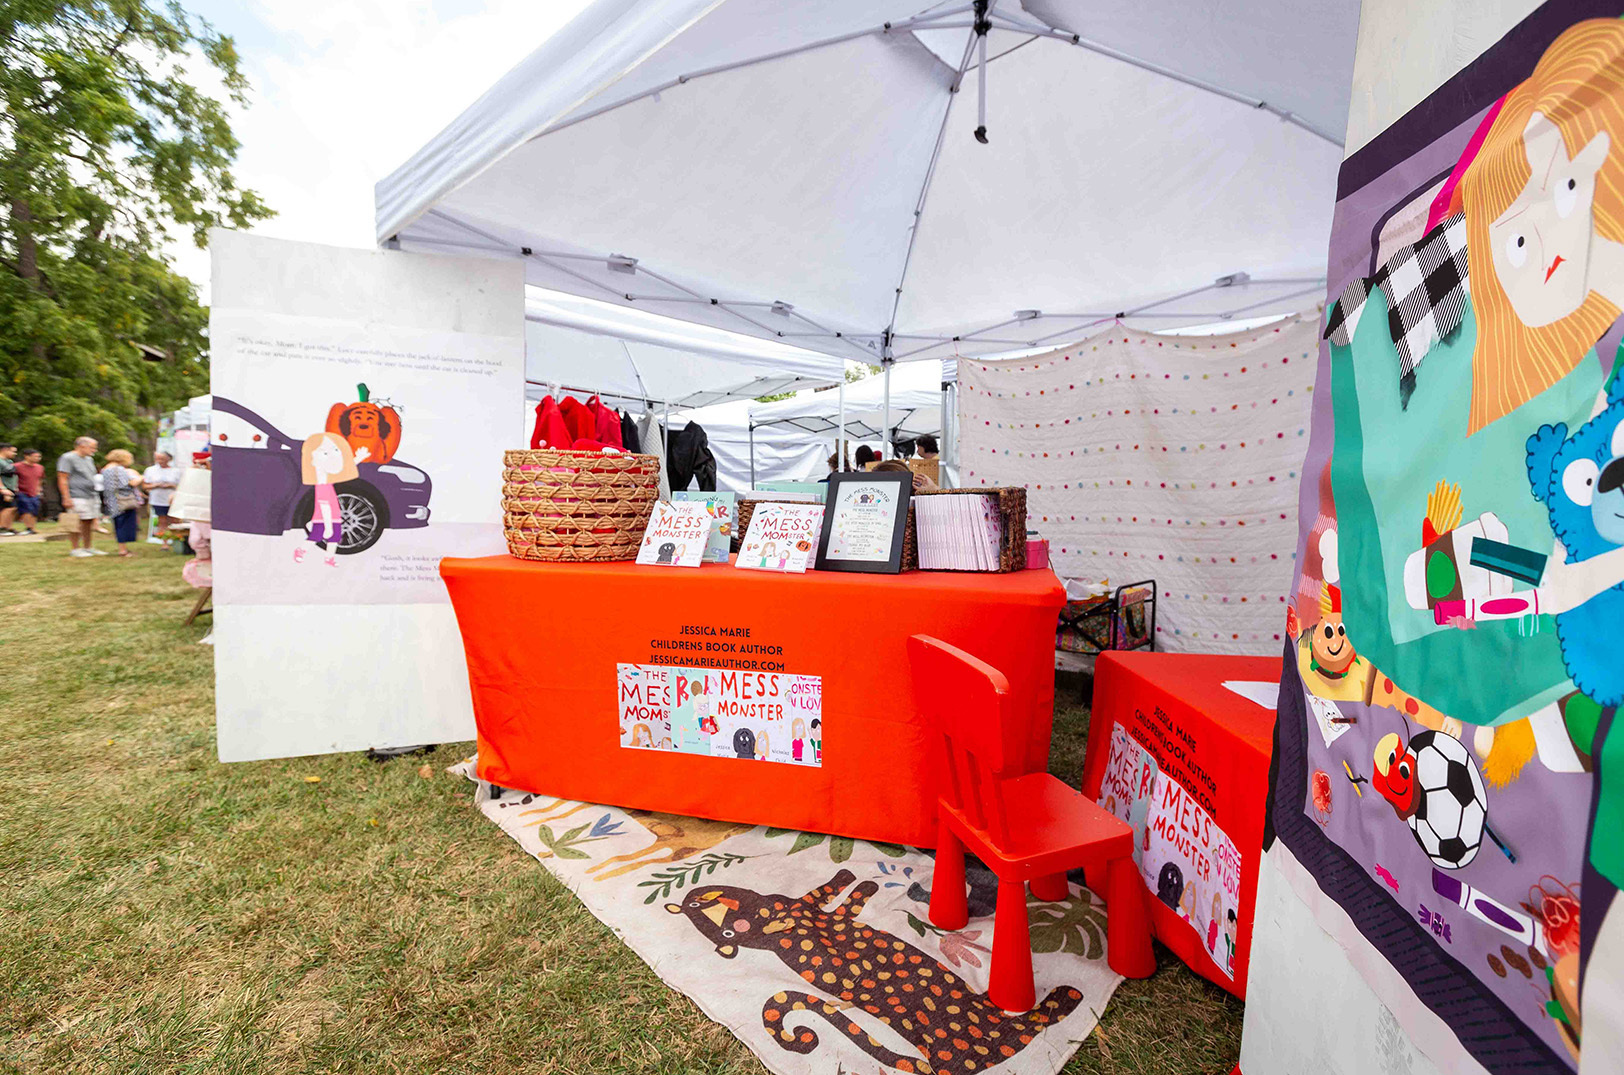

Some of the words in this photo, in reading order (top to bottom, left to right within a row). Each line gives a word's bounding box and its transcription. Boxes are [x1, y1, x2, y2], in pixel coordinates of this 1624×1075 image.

[678, 506, 693, 514] THE
[658, 516, 703, 529] MESS
[763, 518, 812, 531] MESS
[652, 529, 702, 539] MONSTER
[680, 625, 717, 636] JESSICA
[720, 627, 751, 638] MARIE
[650, 639, 703, 651] CHILDRENS
[706, 642, 737, 653] BOOK
[739, 644, 783, 656] AUTHOR
[649, 654, 785, 672] JESSICAMARIEAUTHOR.COM
[644, 670, 667, 683] THE
[720, 671, 779, 700] MESS
[624, 705, 671, 721] MOMS
[718, 700, 783, 721] MONSTER
[1175, 725, 1197, 754] MARIE
[1126, 740, 1140, 763] THE
[1187, 759, 1217, 797] AUTHOR
[1162, 780, 1212, 848] MESS
[1153, 814, 1210, 882] MONSTER
